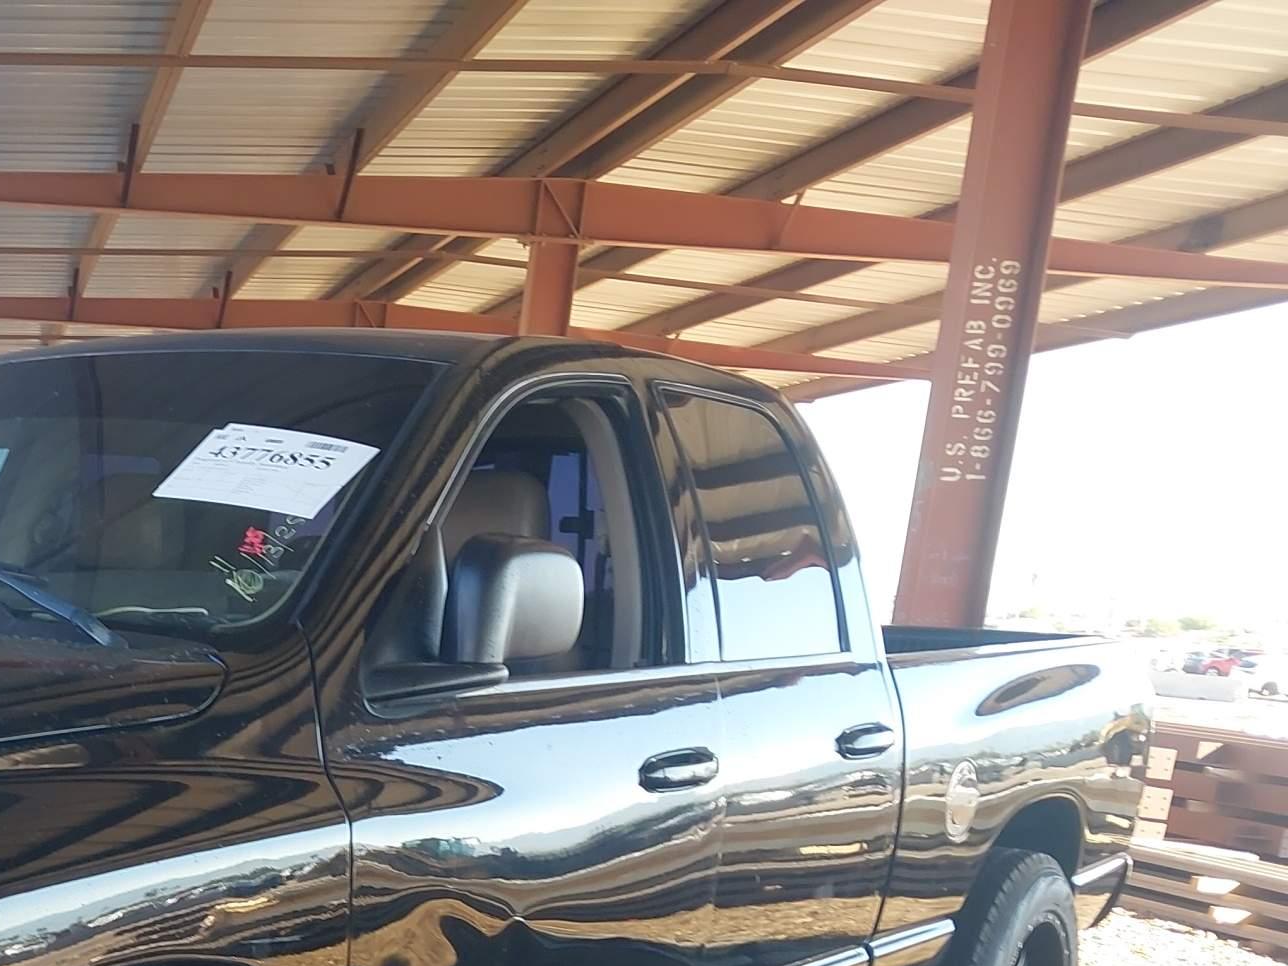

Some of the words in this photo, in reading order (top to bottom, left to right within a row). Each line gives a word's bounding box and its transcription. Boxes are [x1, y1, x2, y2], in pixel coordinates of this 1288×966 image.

[970, 256, 997, 304] INC.
[951, 319, 987, 419] PREFAB
[965, 259, 1021, 481] 1-866-799-0969
[209, 445, 337, 471] 43776855
[940, 435, 968, 482] U.S.
